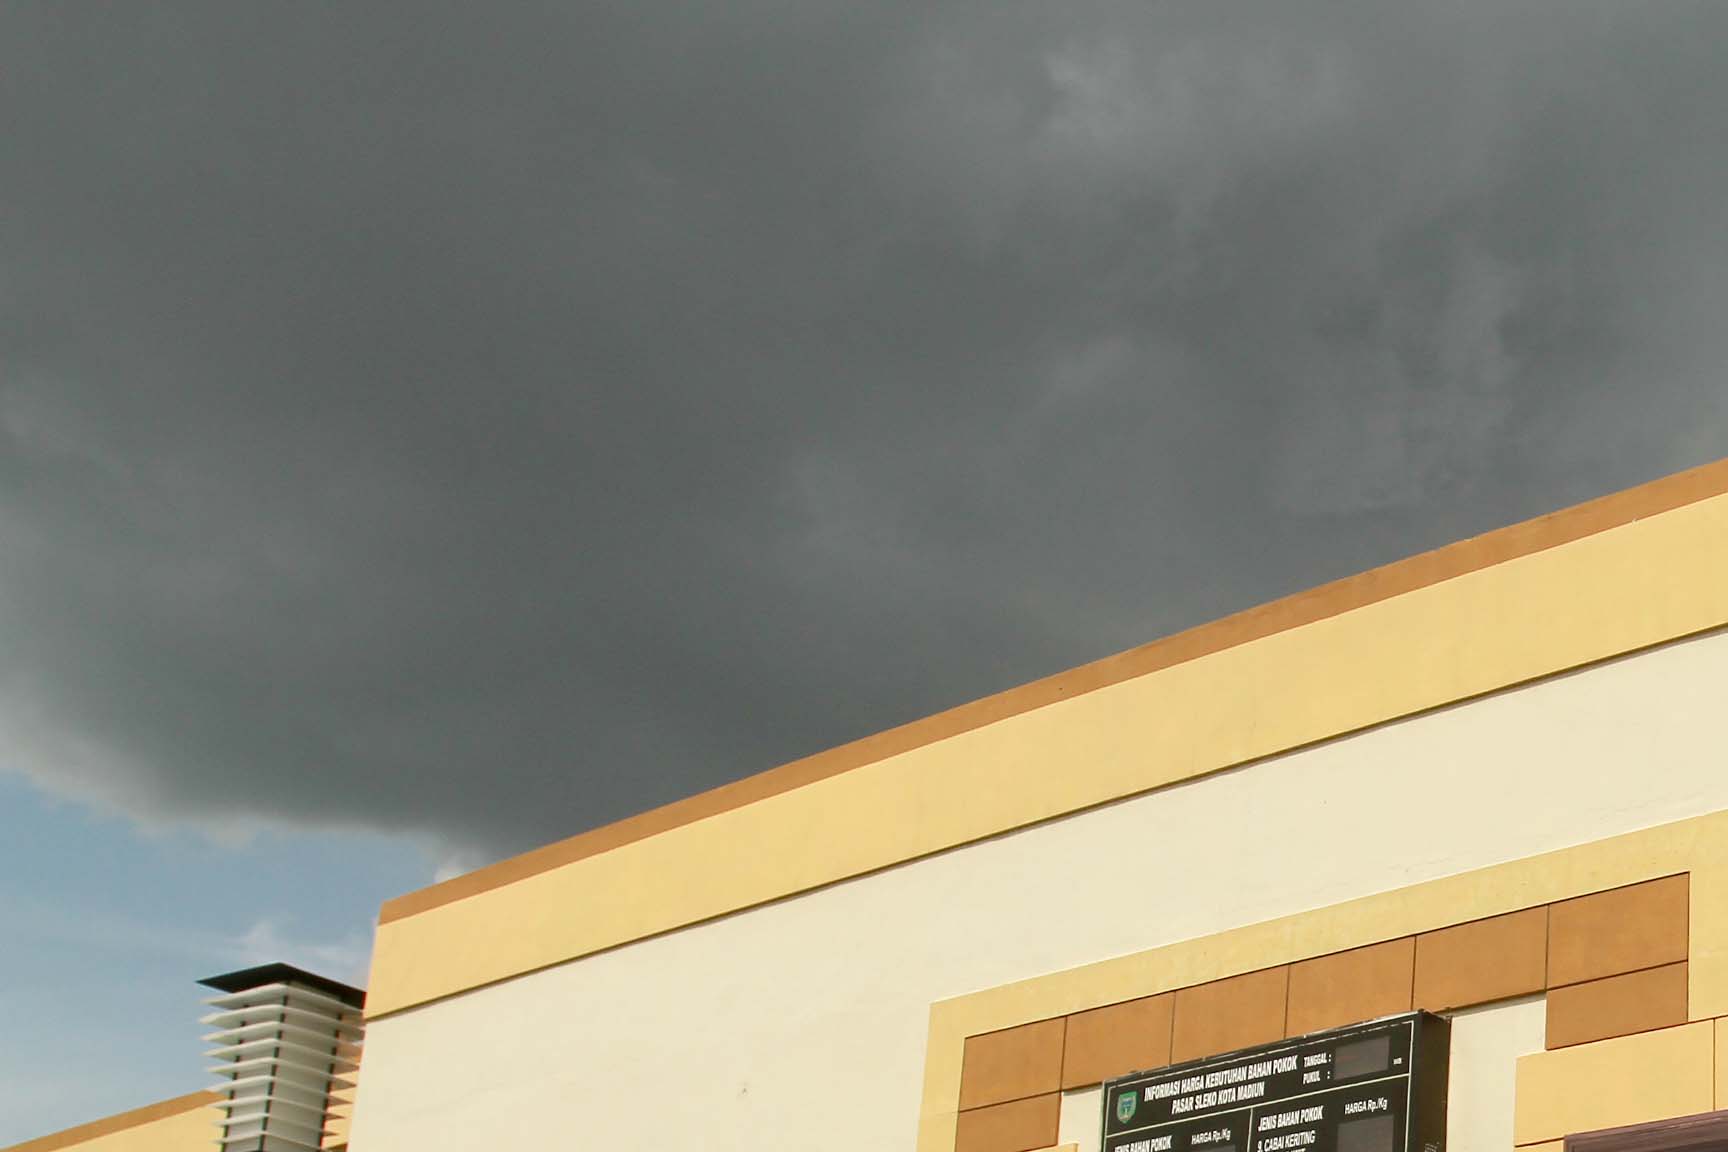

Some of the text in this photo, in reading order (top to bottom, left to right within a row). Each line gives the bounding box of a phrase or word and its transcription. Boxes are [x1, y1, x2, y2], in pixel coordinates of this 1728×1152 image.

[1304, 1052, 1327, 1068] TANGGAL
[1144, 1055, 1299, 1102] INFORMASI HARGA KEBUTUHAN BAHAN POKOK
[1303, 1070, 1321, 1085] PUKUL
[1172, 1081, 1265, 1115] PASAR SLEKO KOTA MADIUN
[1344, 1099, 1367, 1115] HARGA
[1258, 1105, 1324, 1132] JENIS BAHAN POKOK
[1191, 1132, 1212, 1146] HARGA
[1264, 1135, 1285, 1152] CABAI
[1285, 1130, 1316, 1149] KERITING
